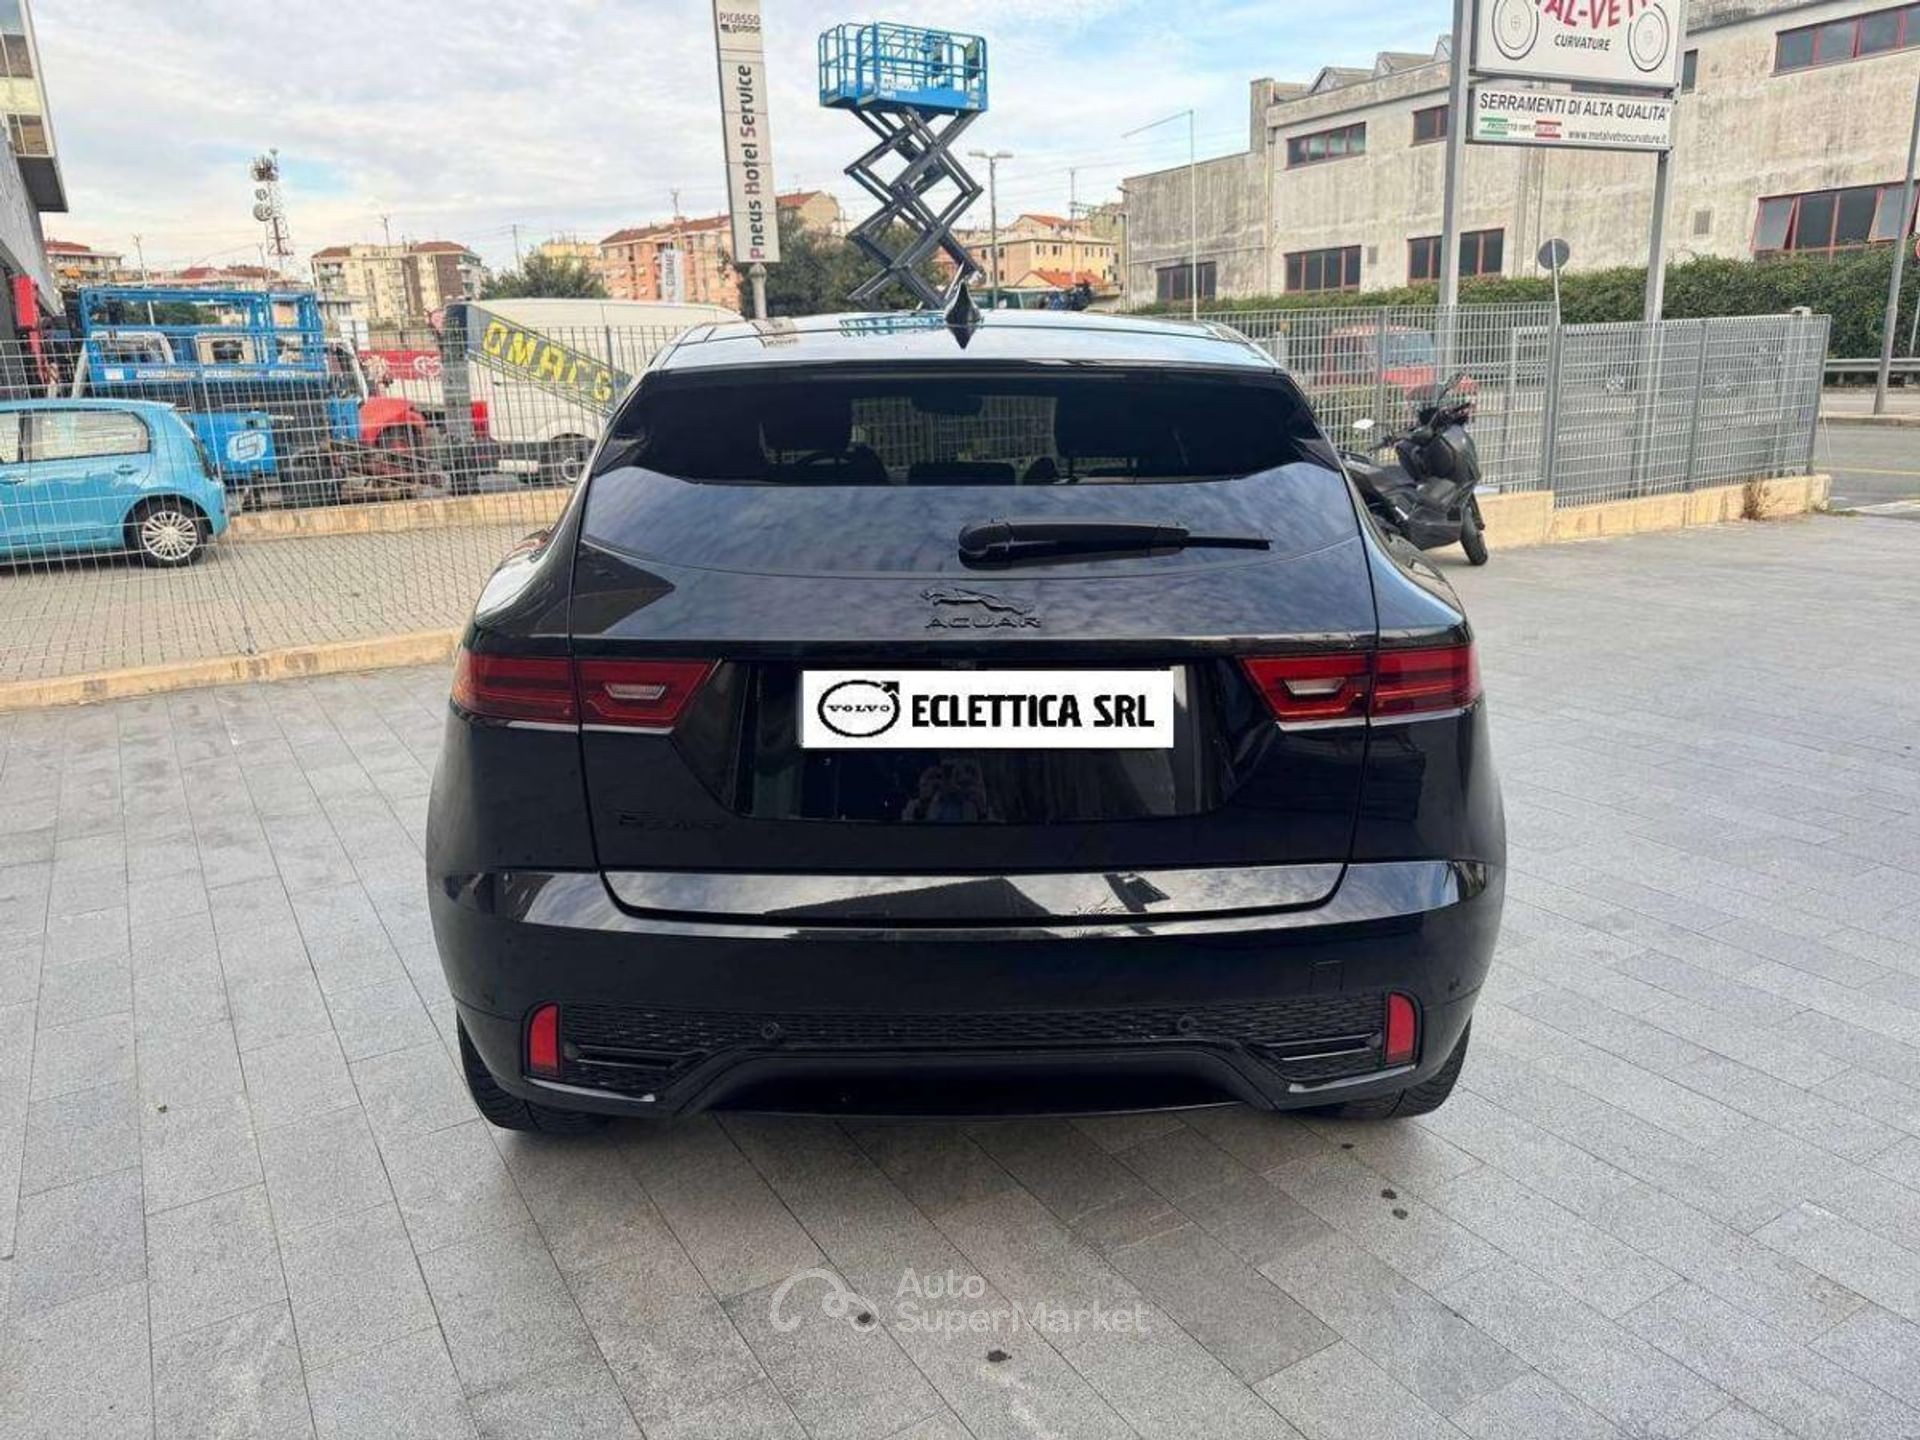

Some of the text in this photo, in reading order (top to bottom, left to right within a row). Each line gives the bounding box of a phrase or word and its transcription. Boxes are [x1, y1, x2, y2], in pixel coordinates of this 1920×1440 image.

[720, 12, 760, 25] PICASSO
[1554, 34, 1611, 51] CURVATURE
[1479, 92, 1566, 114] SERRAMENTI
[1568, 99, 1582, 115] DI
[1583, 102, 1614, 117] ALTA
[736, 64, 766, 260] Pneus Hotel Service
